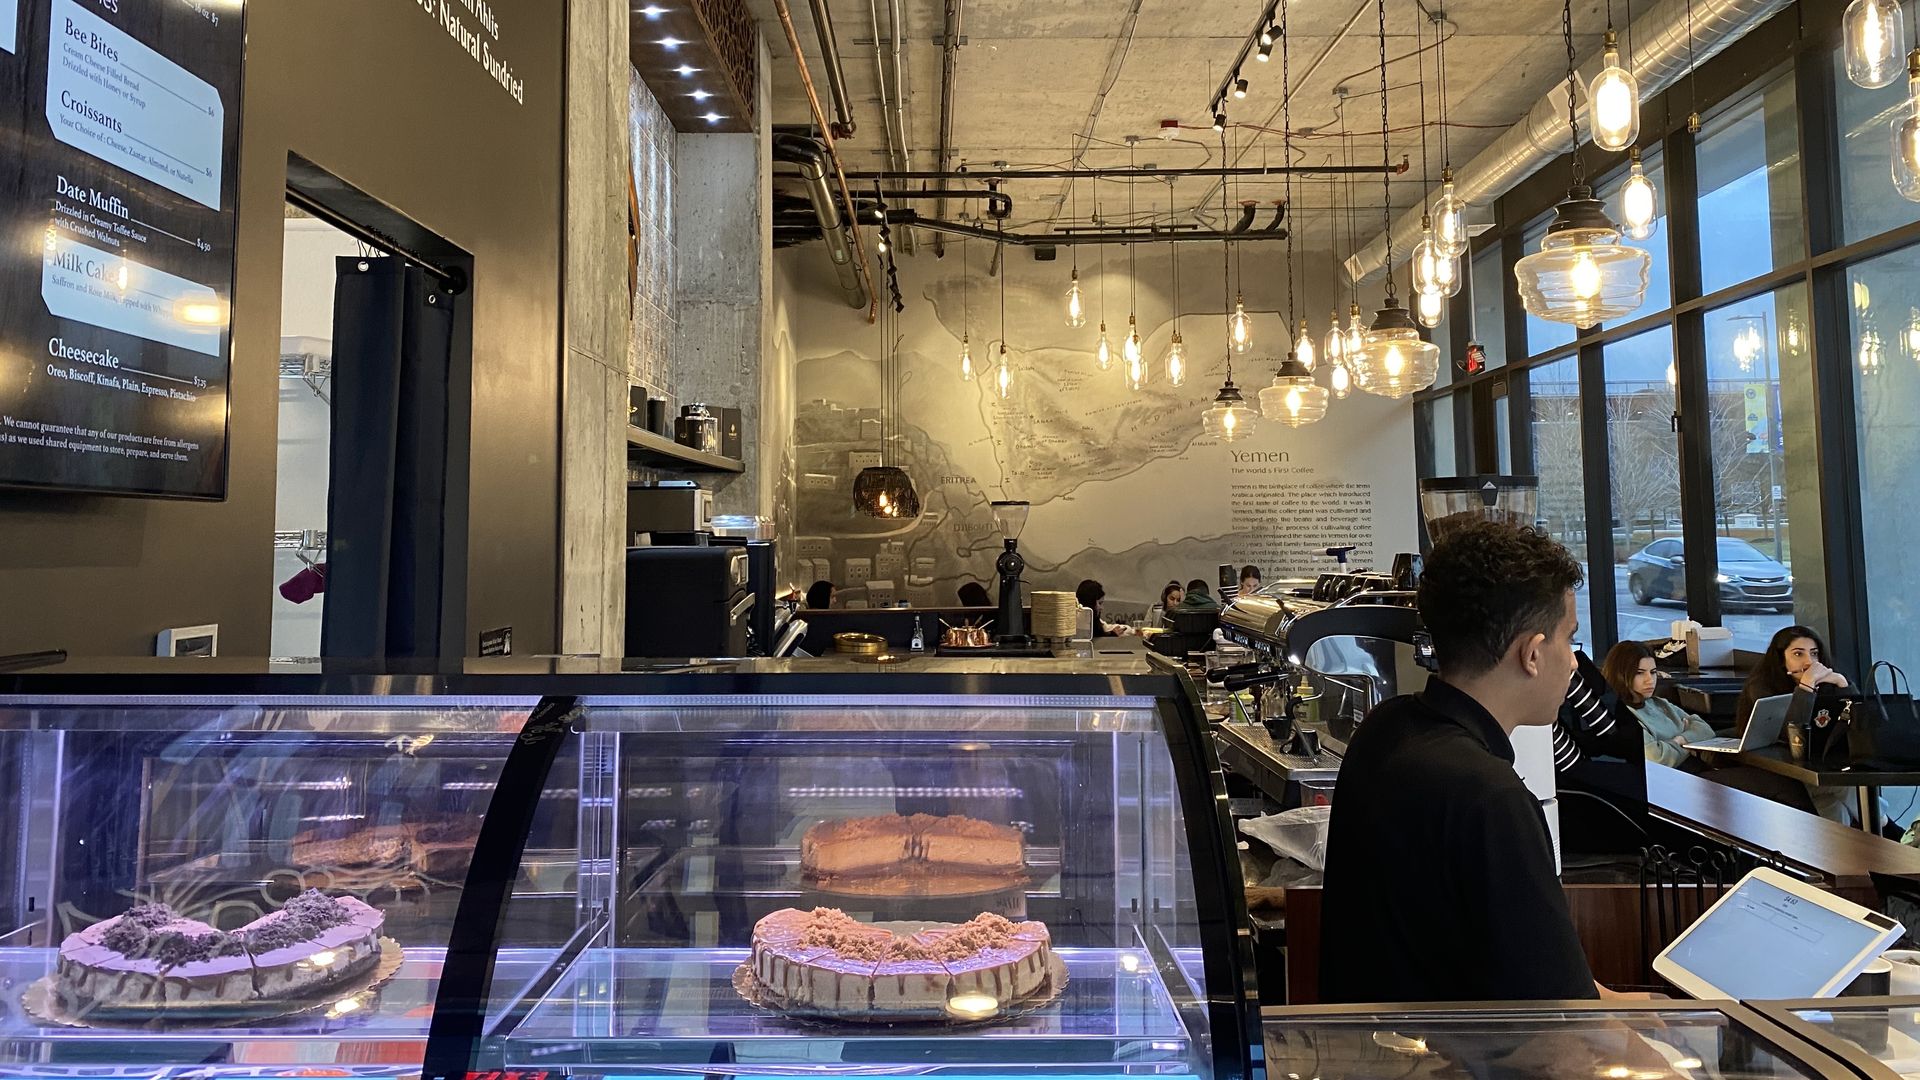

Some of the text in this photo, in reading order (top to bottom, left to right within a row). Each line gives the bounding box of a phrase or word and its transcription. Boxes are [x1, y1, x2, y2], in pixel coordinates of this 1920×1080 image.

[65, 17, 87, 44] Bee
[90, 32, 119, 62] Bites
[439, 0, 523, 105] Natural Sundried
[63, 42, 84, 61] Cream
[84, 54, 106, 73] Cheese
[106, 66, 123, 81] Filled
[62, 56, 146, 110] Drizzled with Honey or Syrup
[60, 113, 74, 128] Your
[75, 121, 96, 138] Choice
[61, 90, 122, 133] Croissants
[56, 175, 87, 203] Date
[88, 188, 129, 220] Muffin
[54, 217, 120, 247] with Crushed Walnuts
[55, 200, 147, 243] Drizzled in Creamy Toffee Sauce
[53, 251, 83, 274] Milk
[51, 274, 75, 290] Saffron
[75, 282, 87, 293] and
[48, 337, 119, 369] Cheesecake
[47, 363, 197, 402] Oreo, Biscoff, Kinafa, Plain, Espresso, Pistachio
[3, 415, 199, 452] We cannot guarantee that any of our products are free from allergens
[8, 434, 17, 443] as
[17, 435, 28, 444] we
[28, 434, 45, 446] used
[45, 436, 68, 449] shared
[68, 440, 102, 453] equipment
[102, 444, 109, 453] to
[109, 446, 126, 456] store,
[126, 447, 149, 459] prepare,
[149, 449, 160, 459] and
[160, 451, 174, 460] serve
[1230, 449, 1289, 463] Yemen
[1273, 466, 1289, 474] First
[1291, 466, 1315, 474] Coffee
[940, 476, 976, 485] ERITREA
